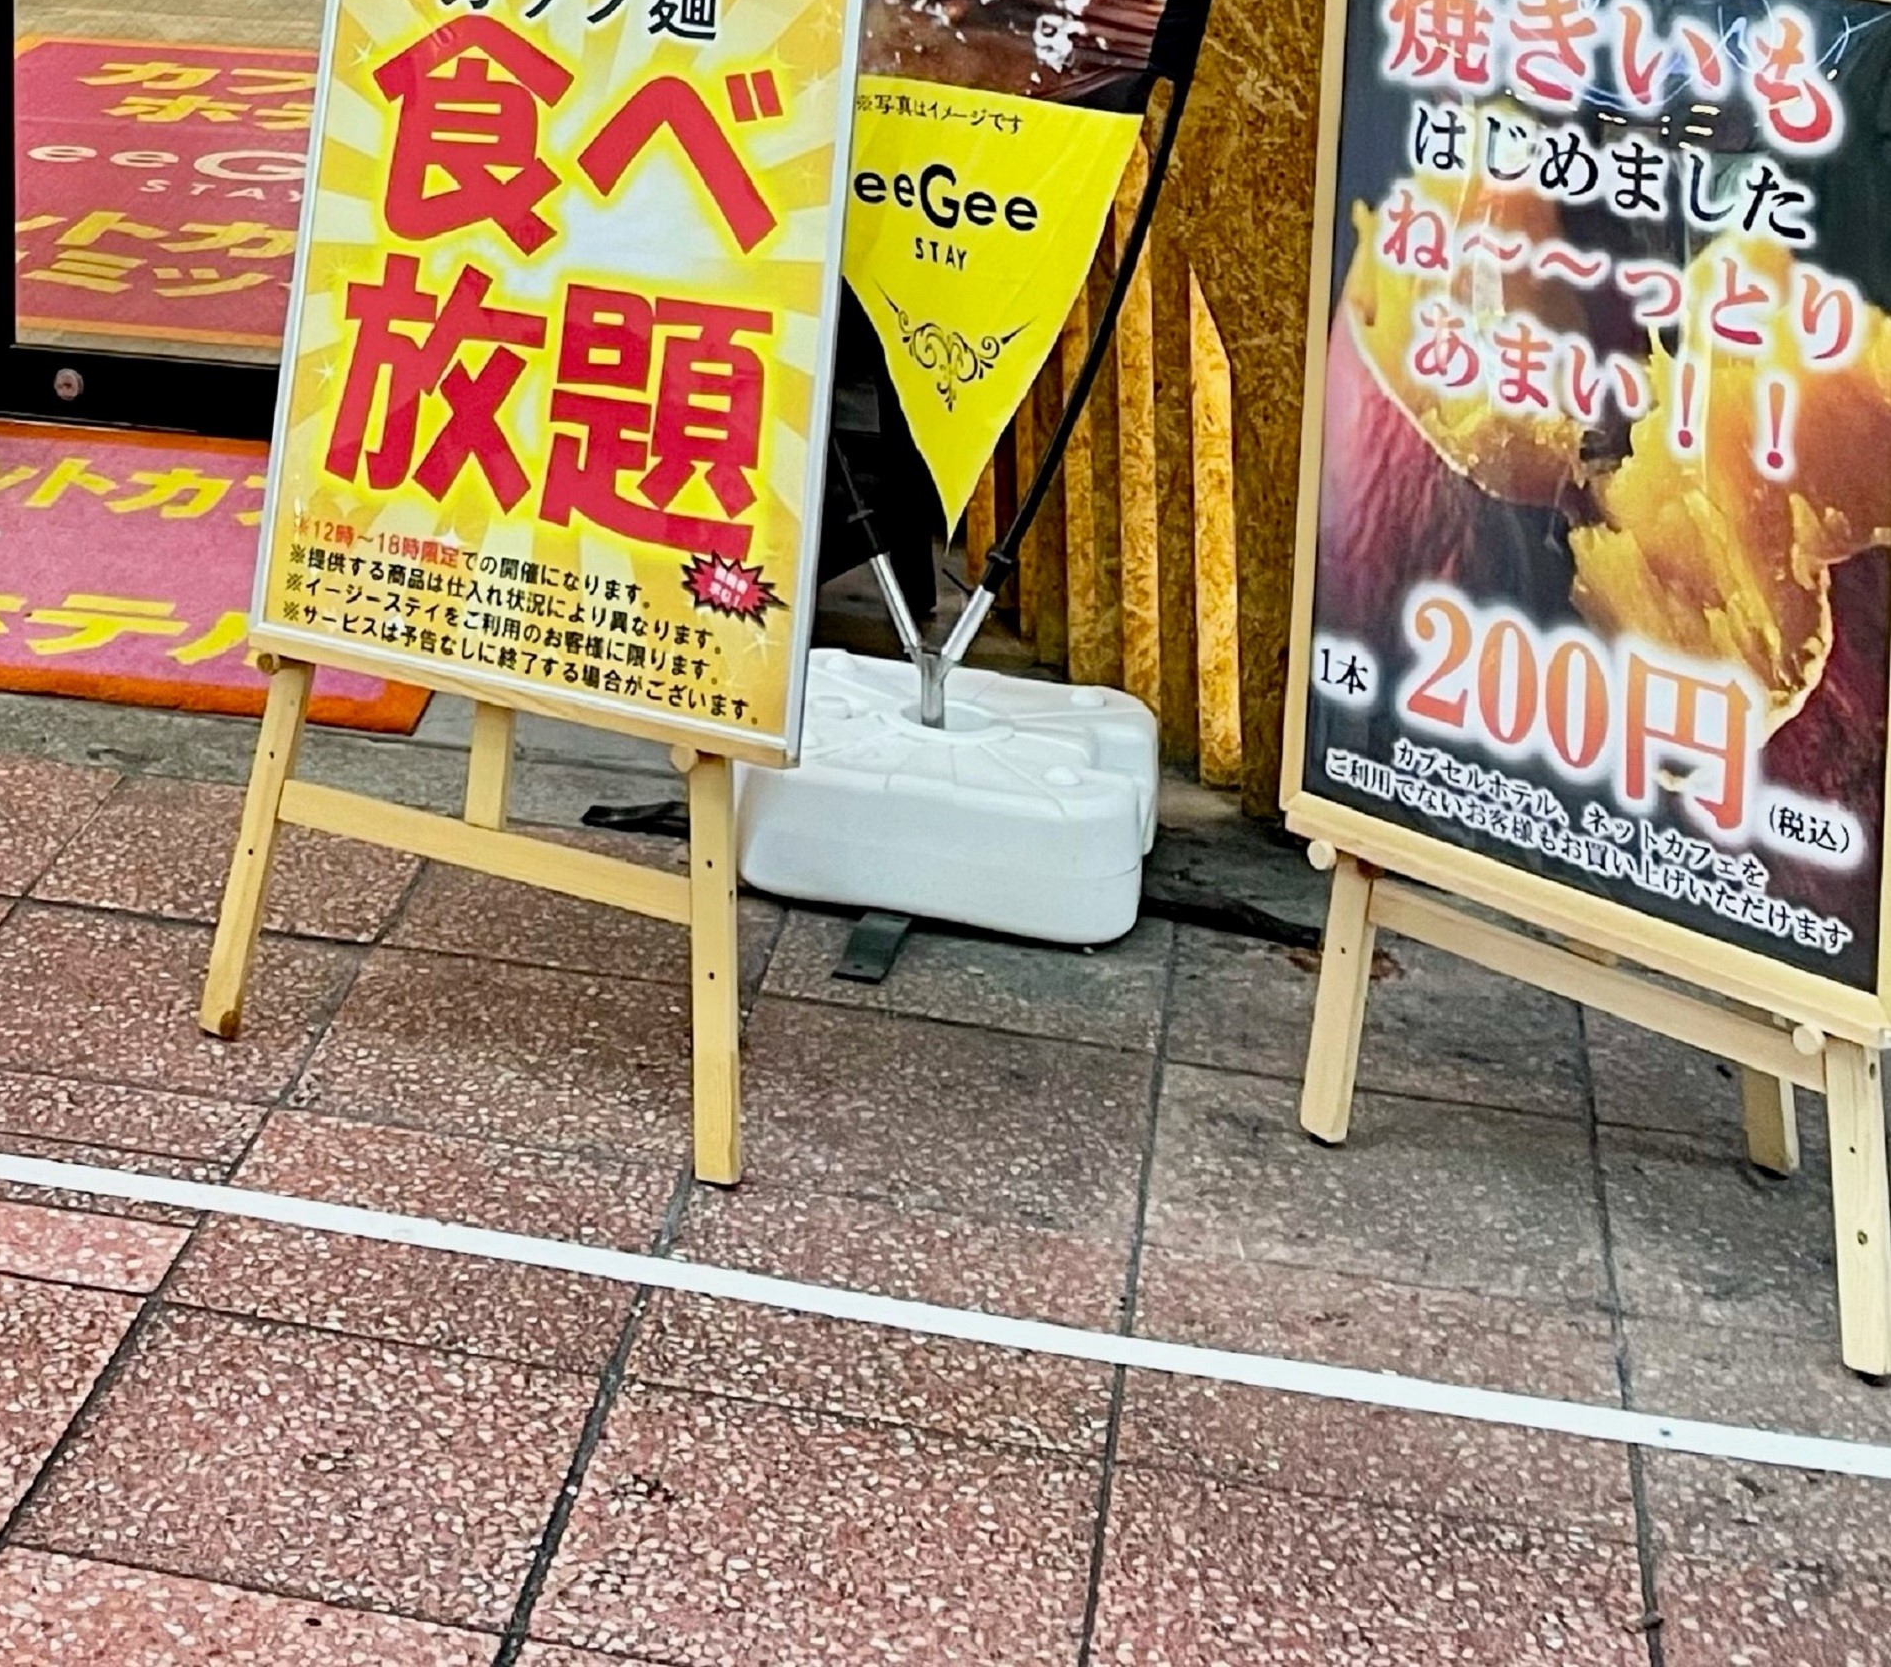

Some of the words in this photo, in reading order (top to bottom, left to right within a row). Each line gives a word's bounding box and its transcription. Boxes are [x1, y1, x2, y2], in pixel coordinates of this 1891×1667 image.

[373, 14, 783, 256] 食べ
[854, 164, 1038, 231] eeGee
[1415, 106, 1807, 240] はじめました
[915, 238, 967, 271] STAY
[325, 253, 774, 560] 放題
[1319, 647, 1368, 696] 1本
[1408, 598, 1752, 830] 200円
